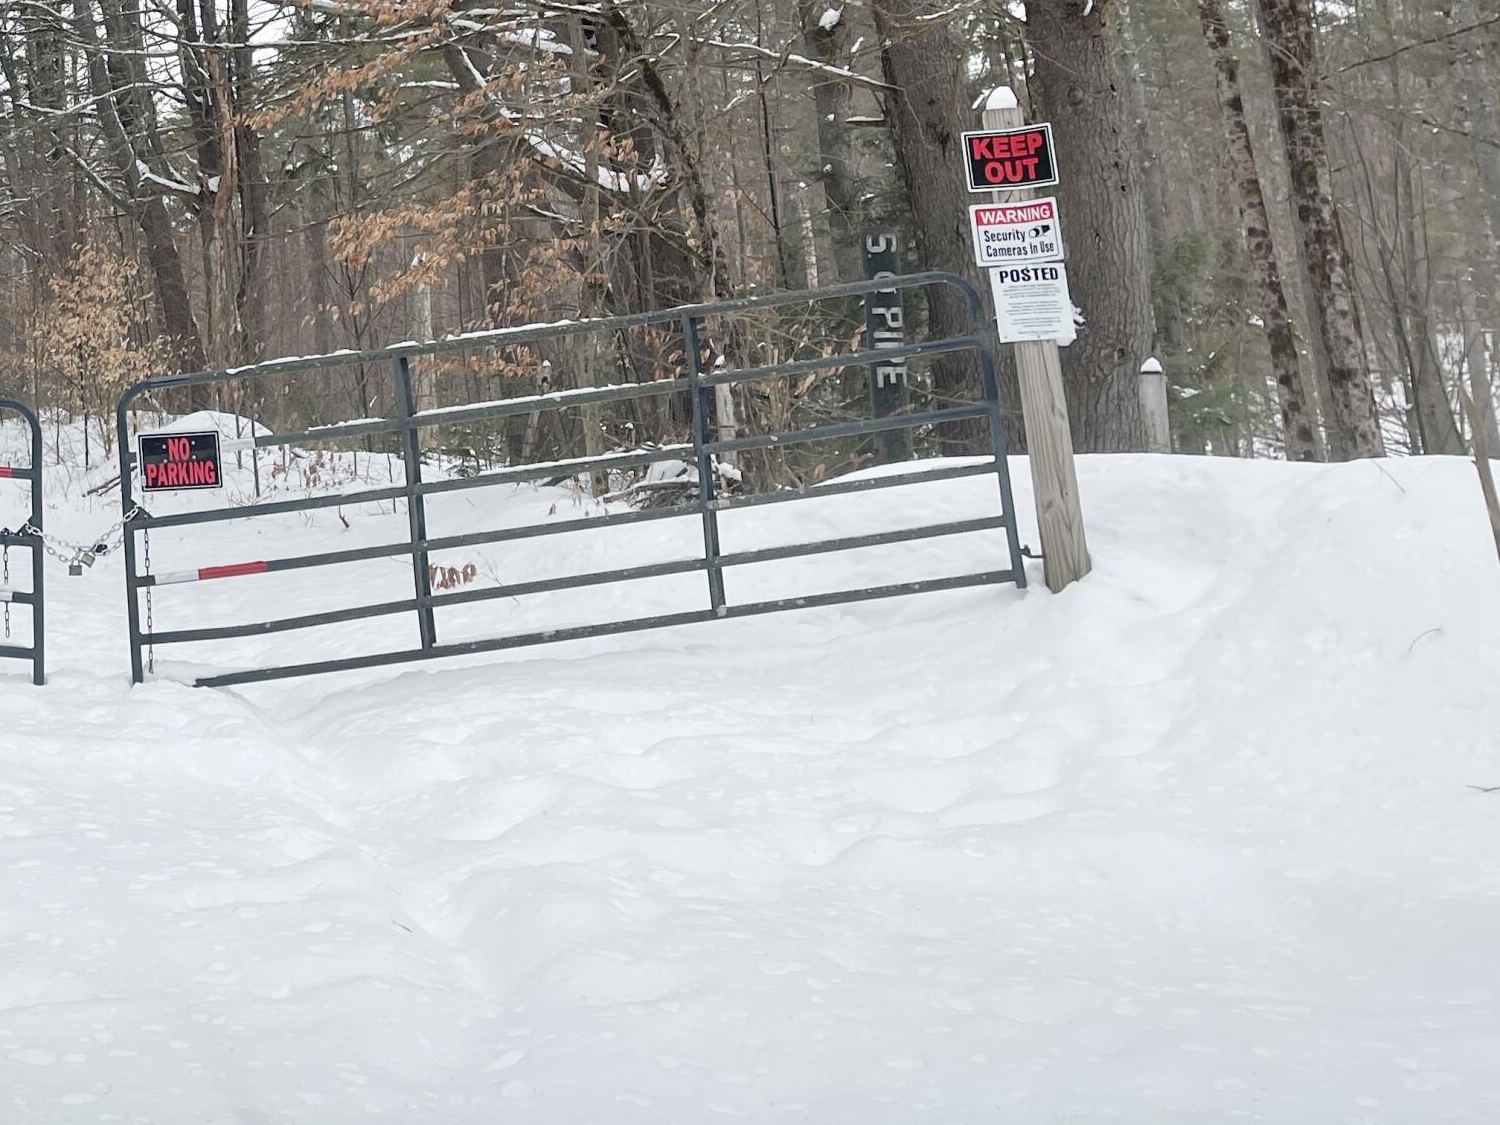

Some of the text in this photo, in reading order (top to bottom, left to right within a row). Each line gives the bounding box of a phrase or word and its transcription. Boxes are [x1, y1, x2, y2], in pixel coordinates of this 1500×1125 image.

[972, 133, 1043, 160] KEEP
[984, 158, 1039, 183] OUT
[980, 205, 1051, 224] WARNING
[984, 228, 1026, 243] Security
[986, 241, 1055, 258] Cameras In Use
[999, 267, 1059, 283] POSTED
[167, 437, 190, 461] NO
[146, 460, 216, 486] PARKING
